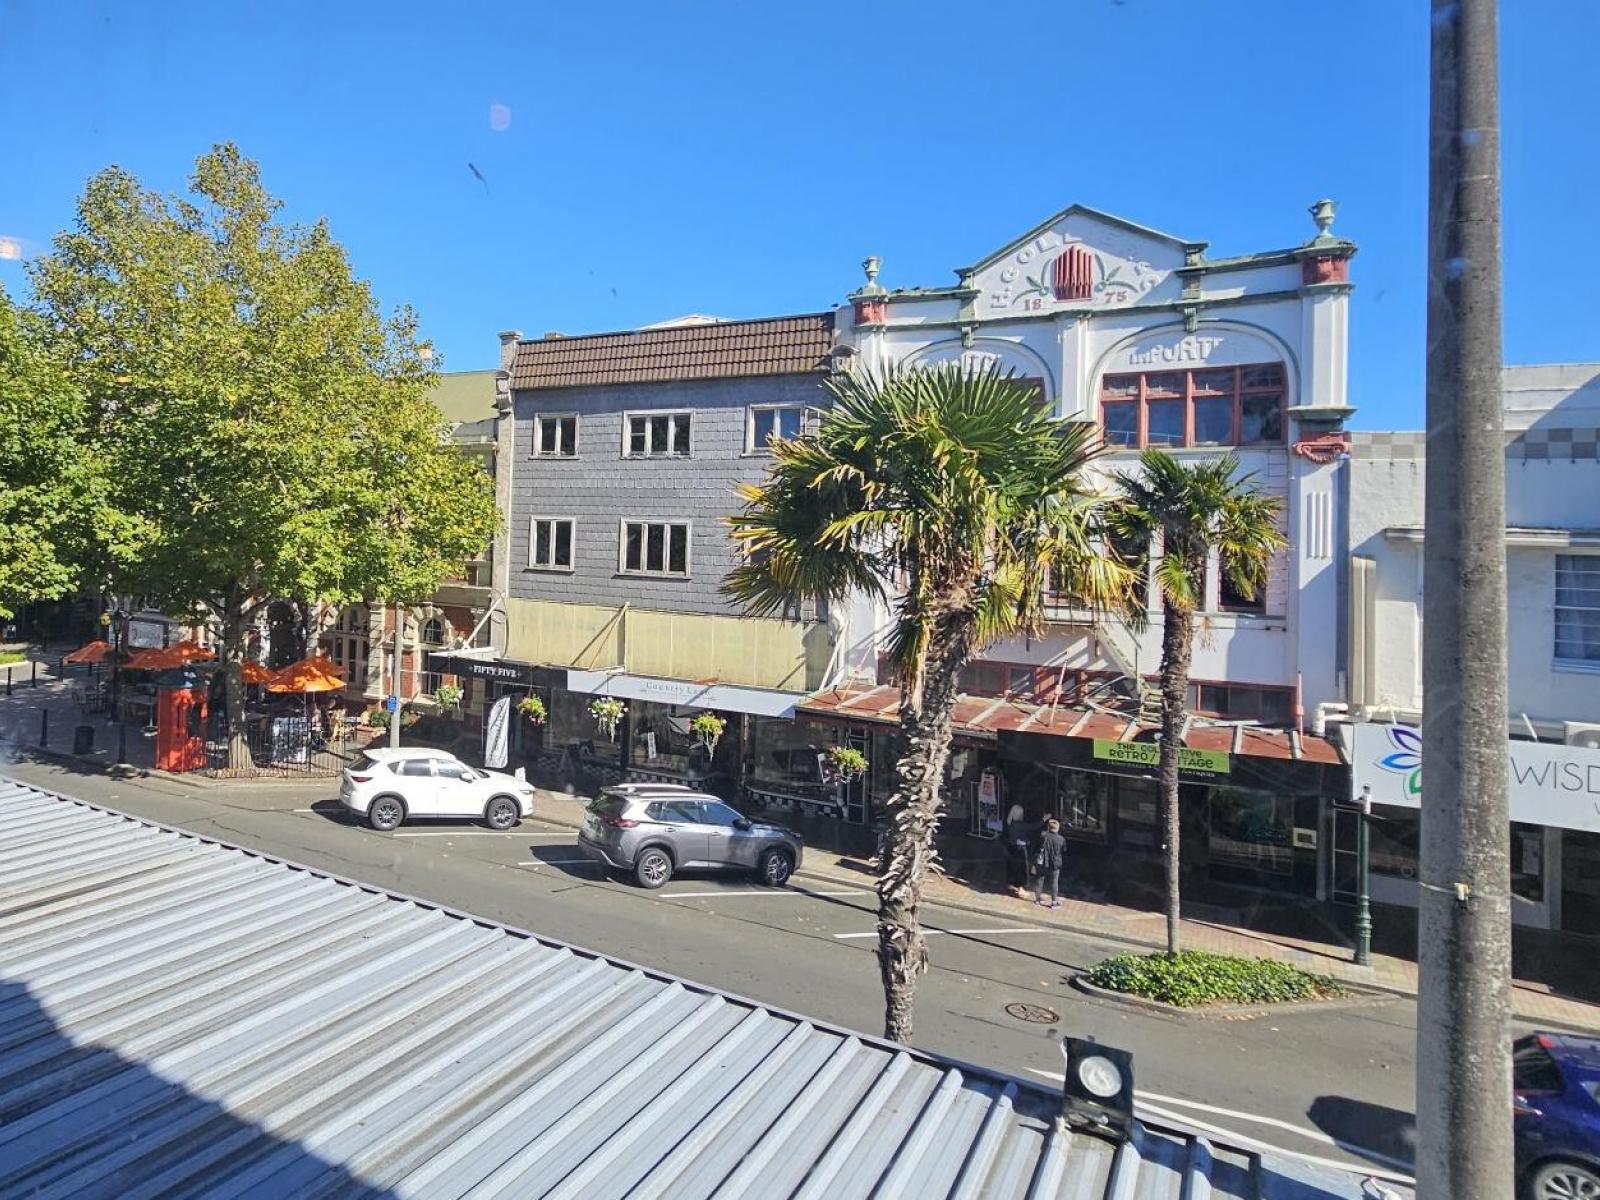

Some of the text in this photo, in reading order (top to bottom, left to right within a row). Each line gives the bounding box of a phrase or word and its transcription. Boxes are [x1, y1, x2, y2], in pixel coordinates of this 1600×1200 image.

[1105, 291, 1129, 305] 75
[473, 664, 517, 678] FIFTY FIVE
[1140, 744, 1203, 758] COLTIVE
